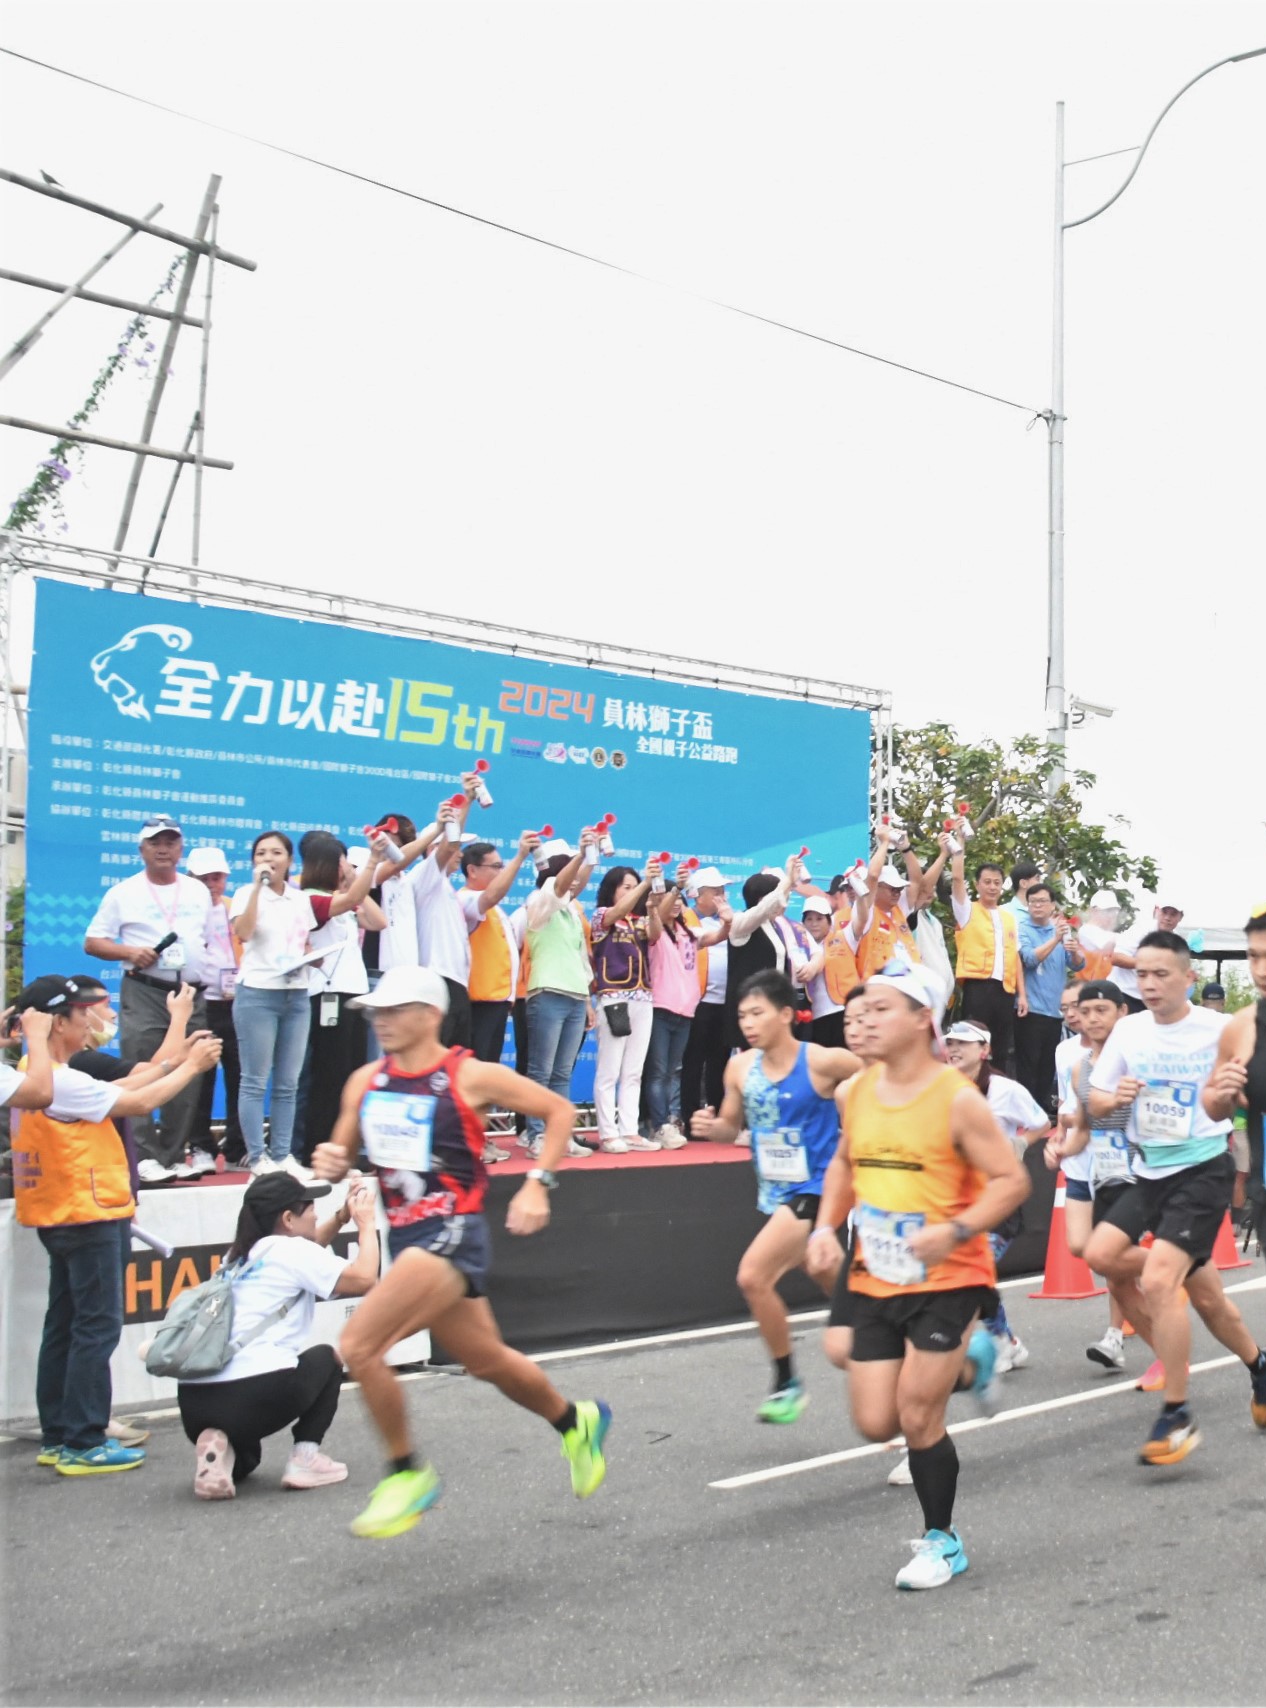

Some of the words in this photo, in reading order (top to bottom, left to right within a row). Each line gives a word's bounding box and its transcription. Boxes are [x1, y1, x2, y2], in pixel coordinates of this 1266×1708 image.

[154, 657, 385, 738] 全力以赴
[384, 677, 506, 754] 15th
[498, 680, 596, 724] 2024
[602, 697, 714, 741] 員林獅子盃
[635, 735, 738, 765] 全國親子公益路跑
[1145, 1101, 1186, 1118] 10059
